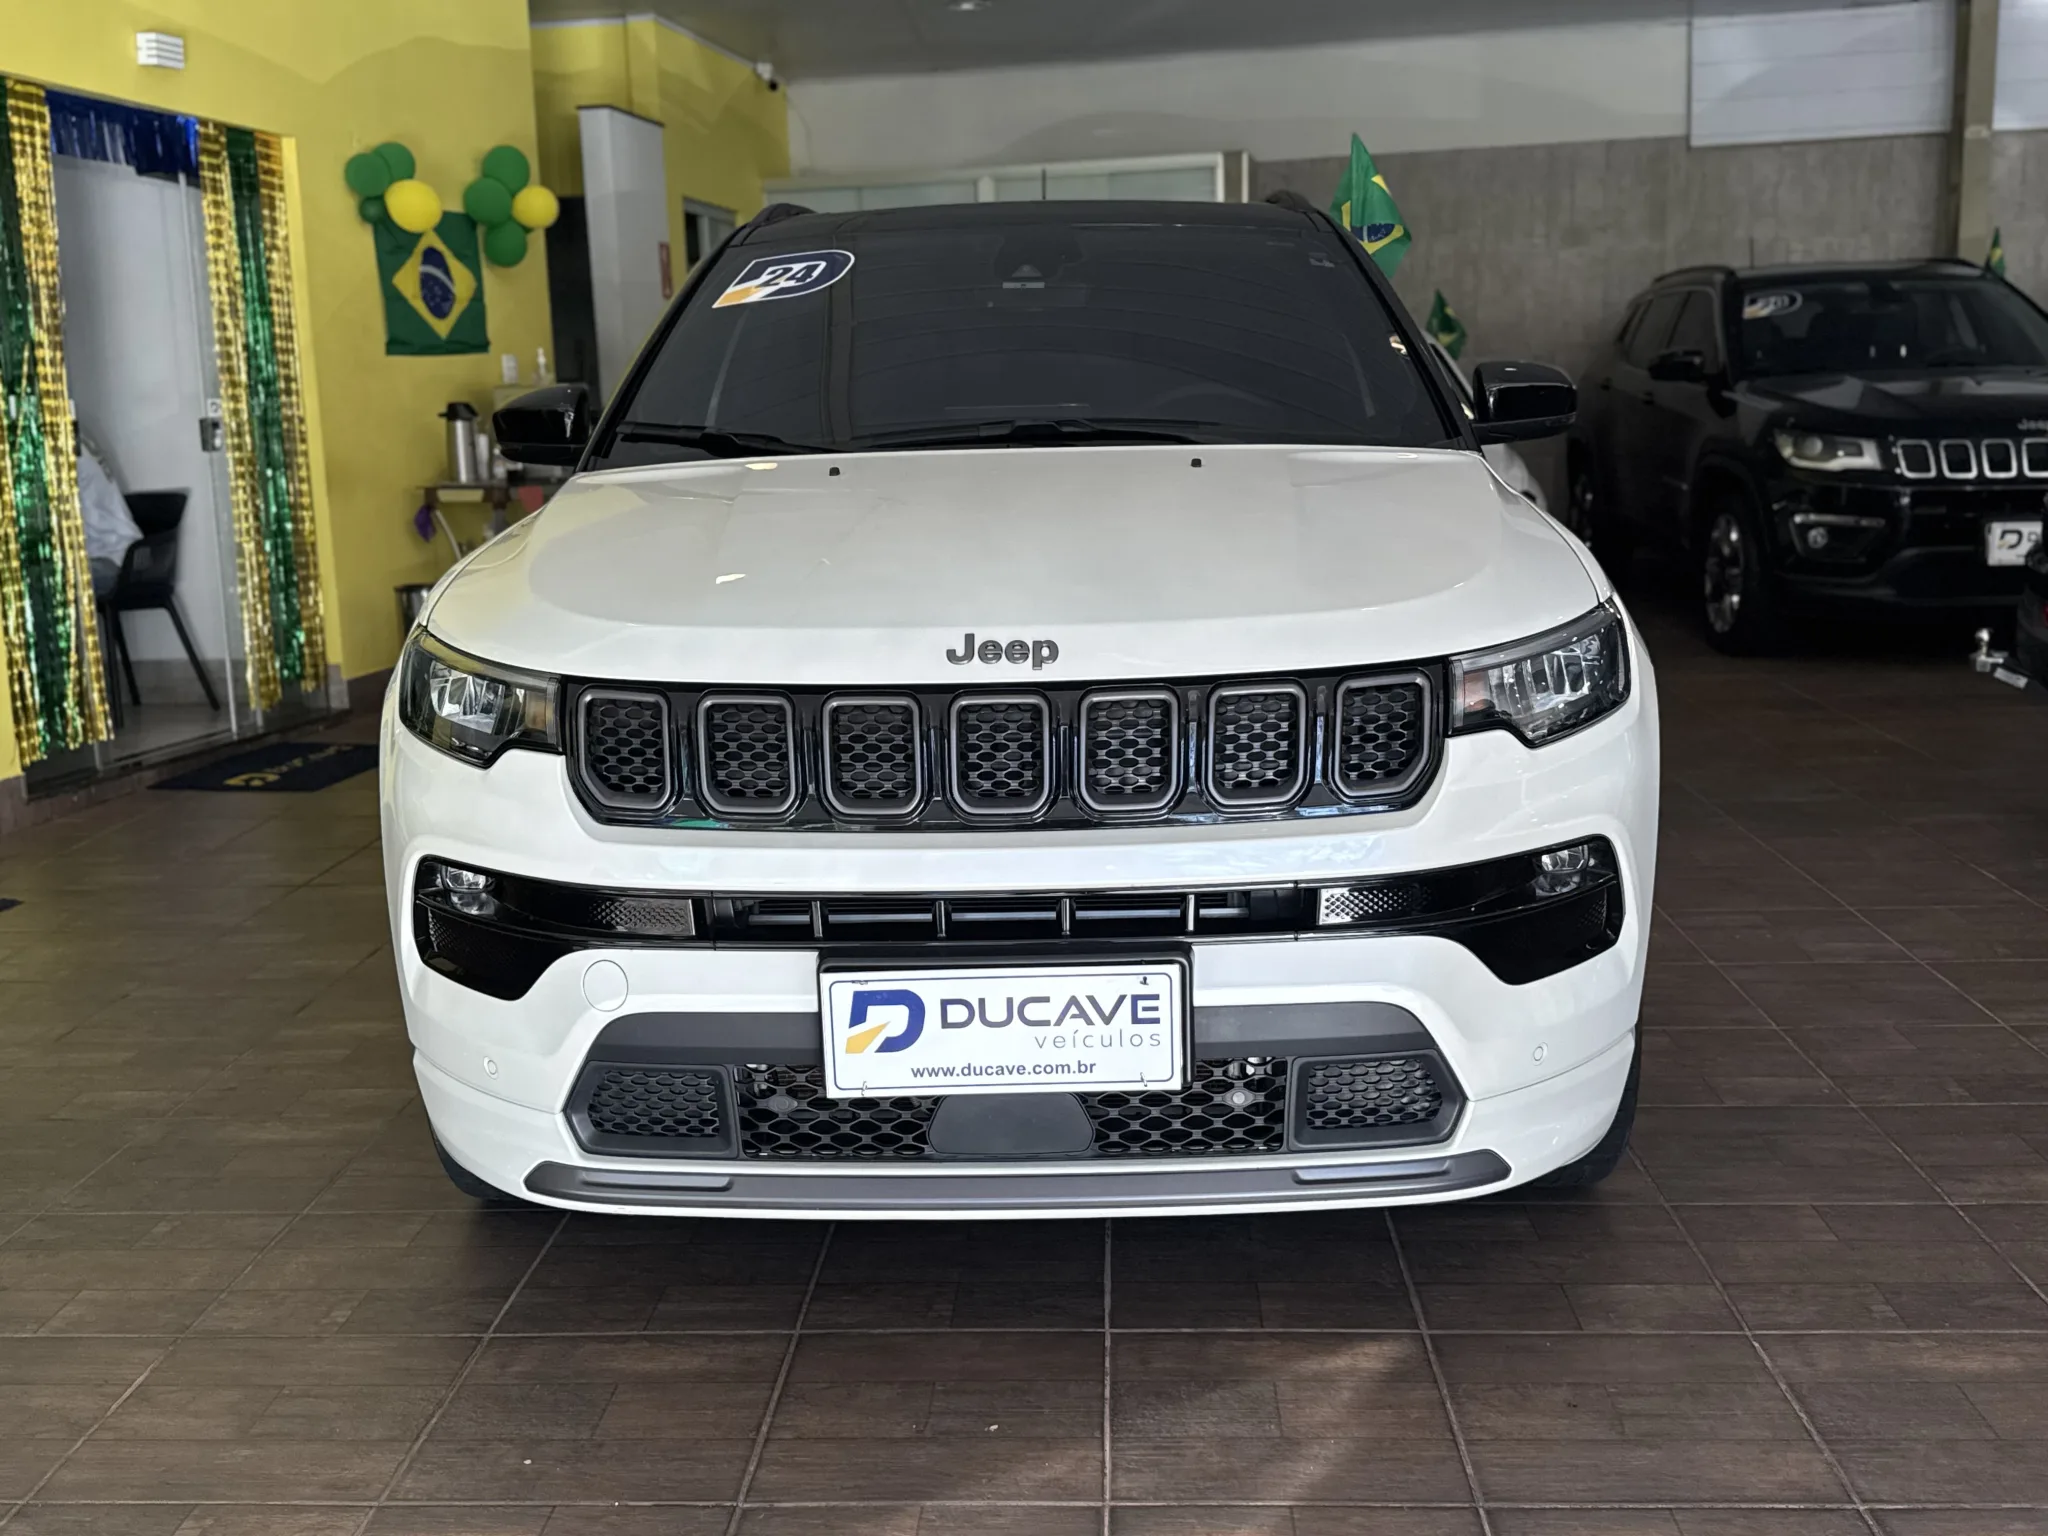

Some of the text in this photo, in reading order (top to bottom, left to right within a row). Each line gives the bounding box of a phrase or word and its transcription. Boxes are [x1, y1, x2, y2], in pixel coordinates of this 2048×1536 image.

[945, 632, 1060, 671] Jeep
[939, 993, 1161, 1029] DUCAVE
[1034, 1028, 1161, 1049] veículos
[910, 1059, 1097, 1078] www.ducave.com.br
